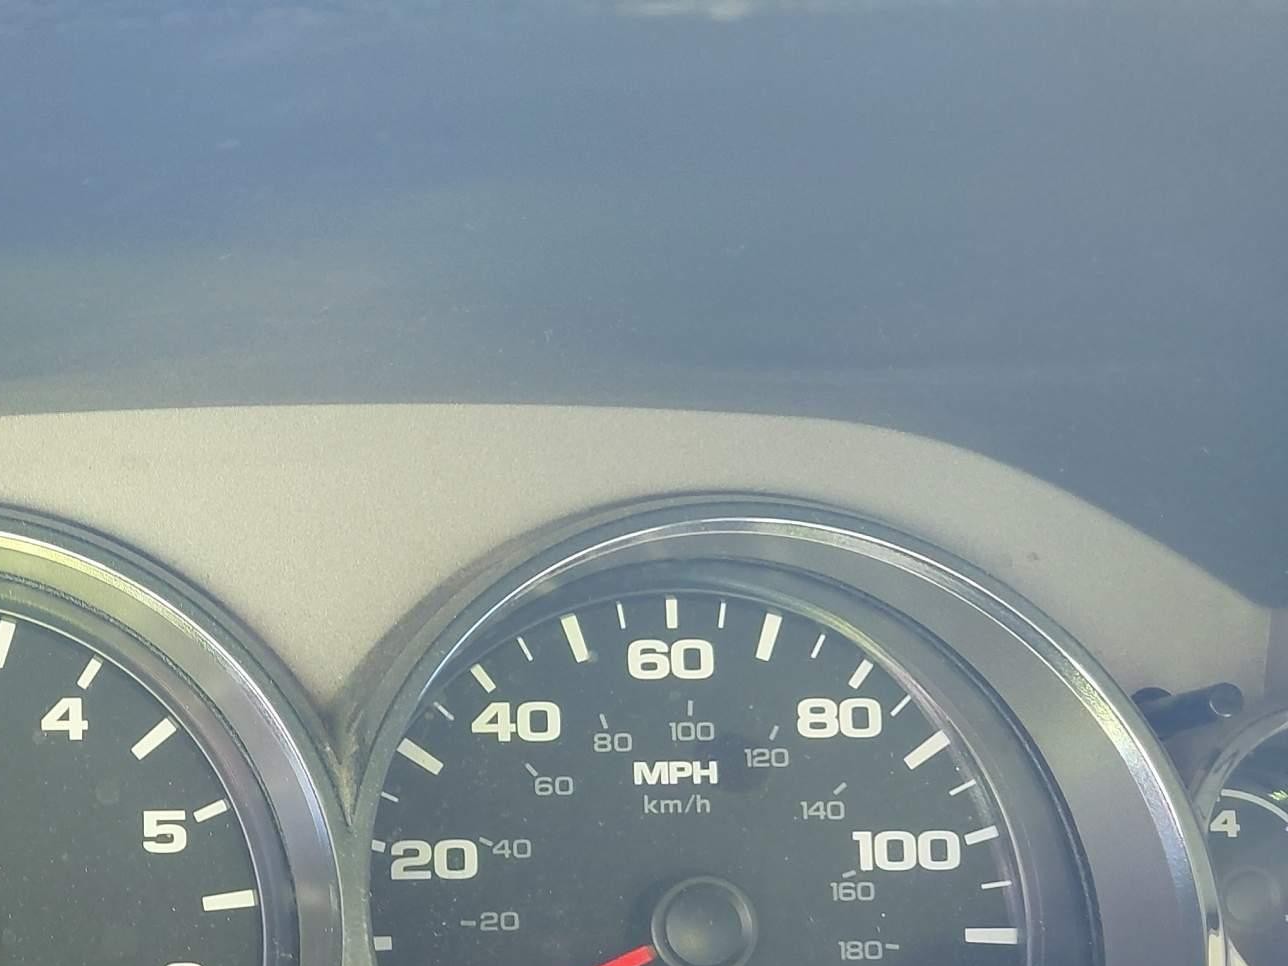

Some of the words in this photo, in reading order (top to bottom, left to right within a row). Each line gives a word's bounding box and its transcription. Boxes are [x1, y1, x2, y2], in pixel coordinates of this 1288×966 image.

[627, 639, 714, 680] 60
[40, 697, 89, 741] 4
[471, 701, 561, 743] 40
[796, 697, 882, 738] 80
[669, 721, 715, 742] 100
[593, 734, 633, 753] 80
[744, 748, 789, 768] 120
[633, 760, 718, 784] MPH
[533, 775, 574, 796] 60
[643, 795, 711, 815] km/h
[800, 800, 845, 821] 140
[143, 811, 187, 853] 5
[491, 839, 532, 859] 40
[853, 831, 961, 871] 100
[391, 840, 479, 880] 20
[830, 881, 875, 902] 160
[479, 912, 520, 931] 20
[839, 940, 883, 960] 180
